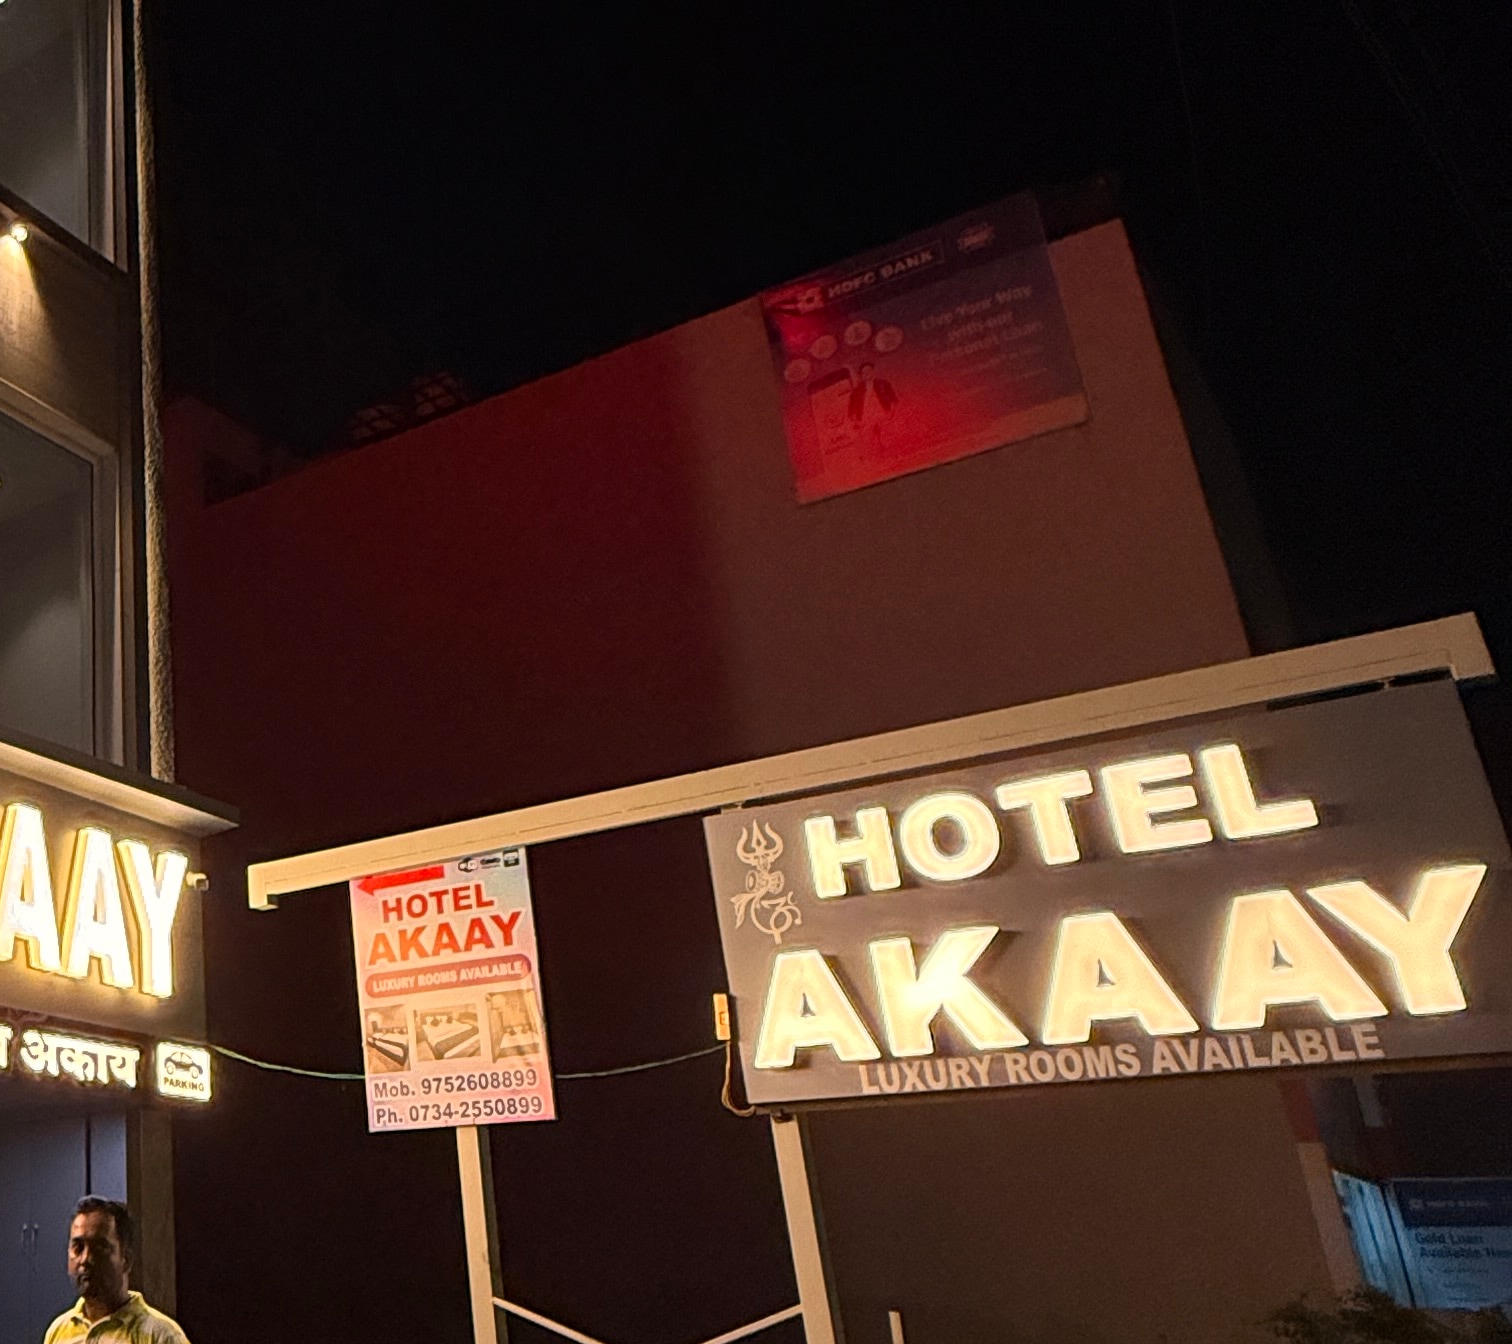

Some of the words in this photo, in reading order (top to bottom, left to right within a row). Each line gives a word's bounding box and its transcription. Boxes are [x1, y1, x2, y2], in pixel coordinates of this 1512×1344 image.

[828, 271, 877, 299] HDFC
[881, 249, 935, 279] BANK
[995, 282, 1034, 308] Way
[804, 742, 1319, 899] HOTEL
[382, 883, 494, 924] HOTEL
[368, 911, 521, 967] AKAAY
[373, 976, 415, 992] LUXURY
[418, 970, 456, 986] ROOMS
[459, 961, 523, 982] AVAILABLE
[754, 863, 1488, 1070] AKAAY
[20, 1029, 140, 1088] अकाय
[859, 1054, 991, 1096] LUXURY
[1004, 1043, 1141, 1084] ROOMS
[1152, 1022, 1385, 1075] AVAILABLE
[164, 1076, 205, 1091] PARKING
[374, 1081, 416, 1098] Mob.
[421, 1069, 537, 1095] 9752608899
[376, 1107, 403, 1124] Ph.
[409, 1096, 542, 1122] 0734-2550899
